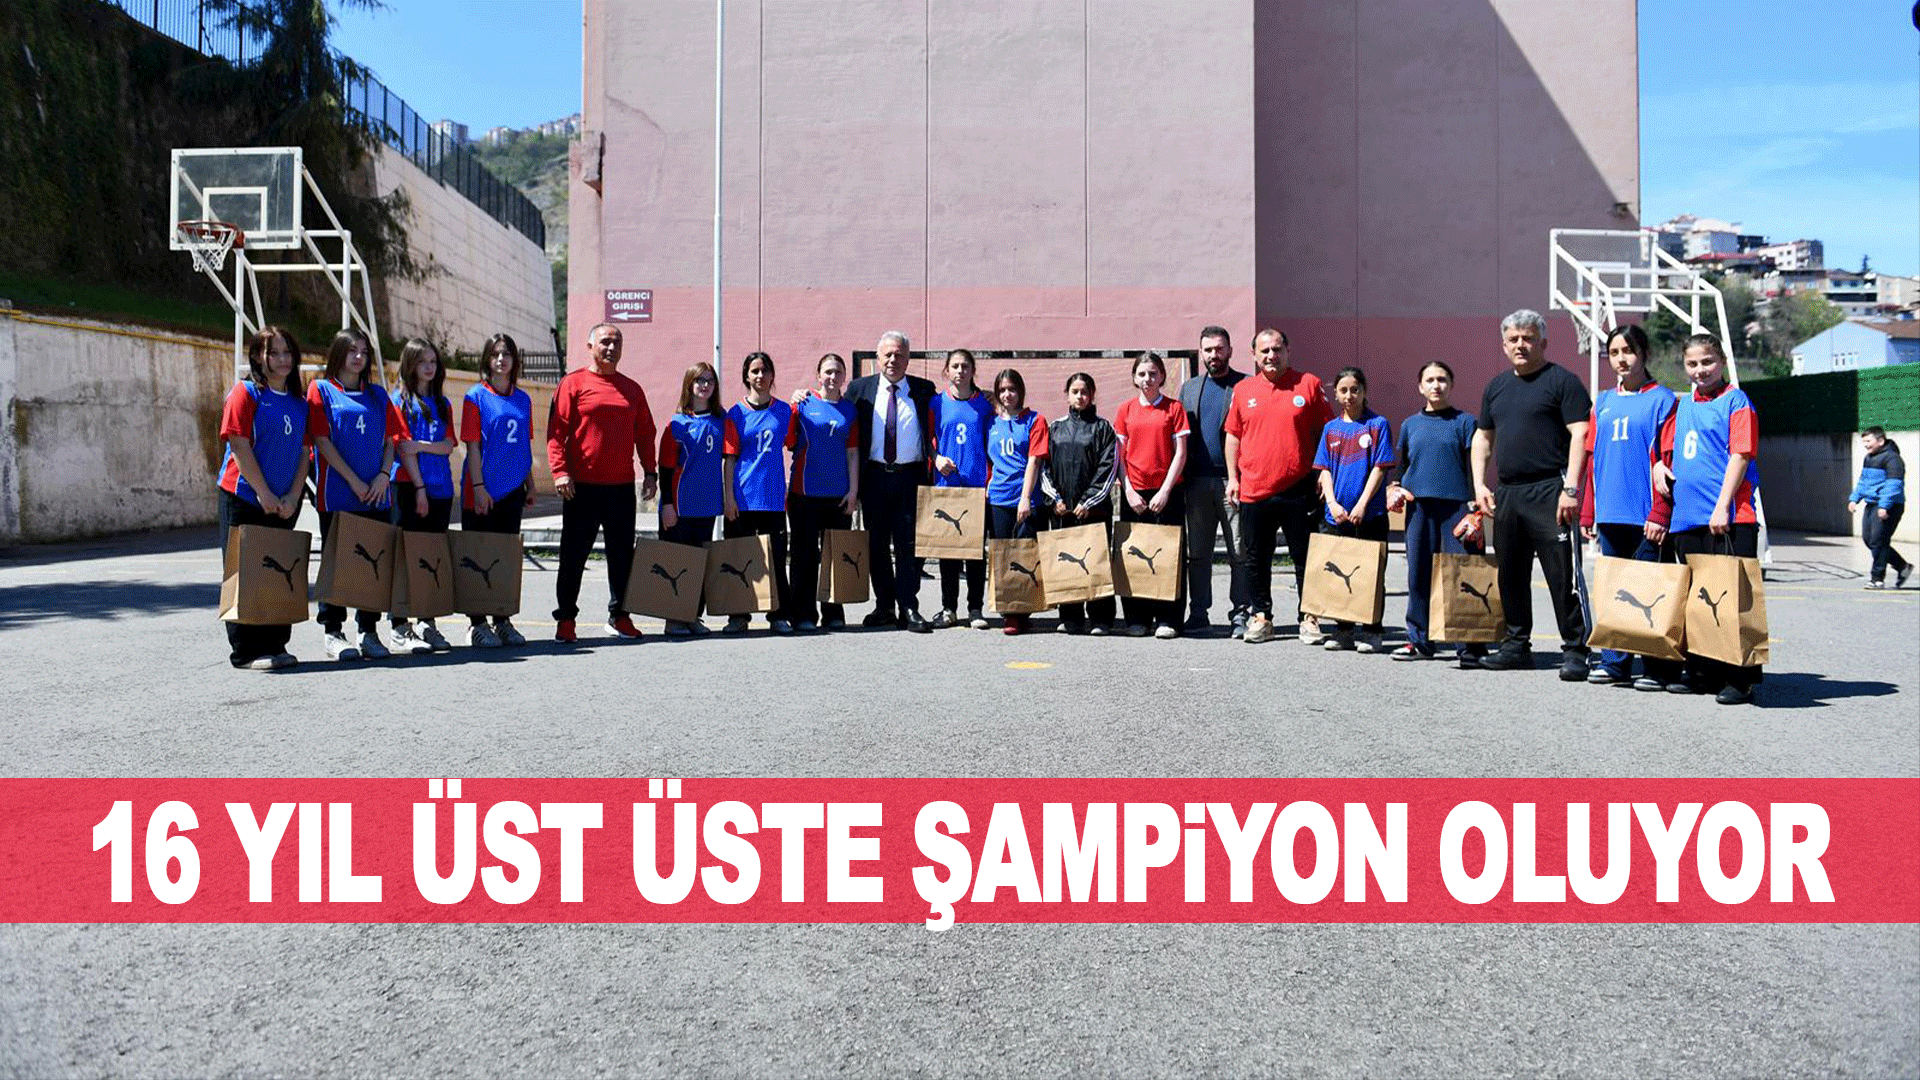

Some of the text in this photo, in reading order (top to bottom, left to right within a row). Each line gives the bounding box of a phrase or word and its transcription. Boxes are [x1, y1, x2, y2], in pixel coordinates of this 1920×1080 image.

[284, 415, 292, 434] 8
[355, 414, 366, 434] 4
[506, 419, 518, 443] 2
[829, 420, 838, 437] 7
[956, 423, 967, 445] 3
[1611, 415, 1629, 441] 11
[706, 435, 714, 453] 9
[755, 429, 774, 453] 12
[999, 437, 1014, 456] 10
[1683, 429, 1698, 460] 6
